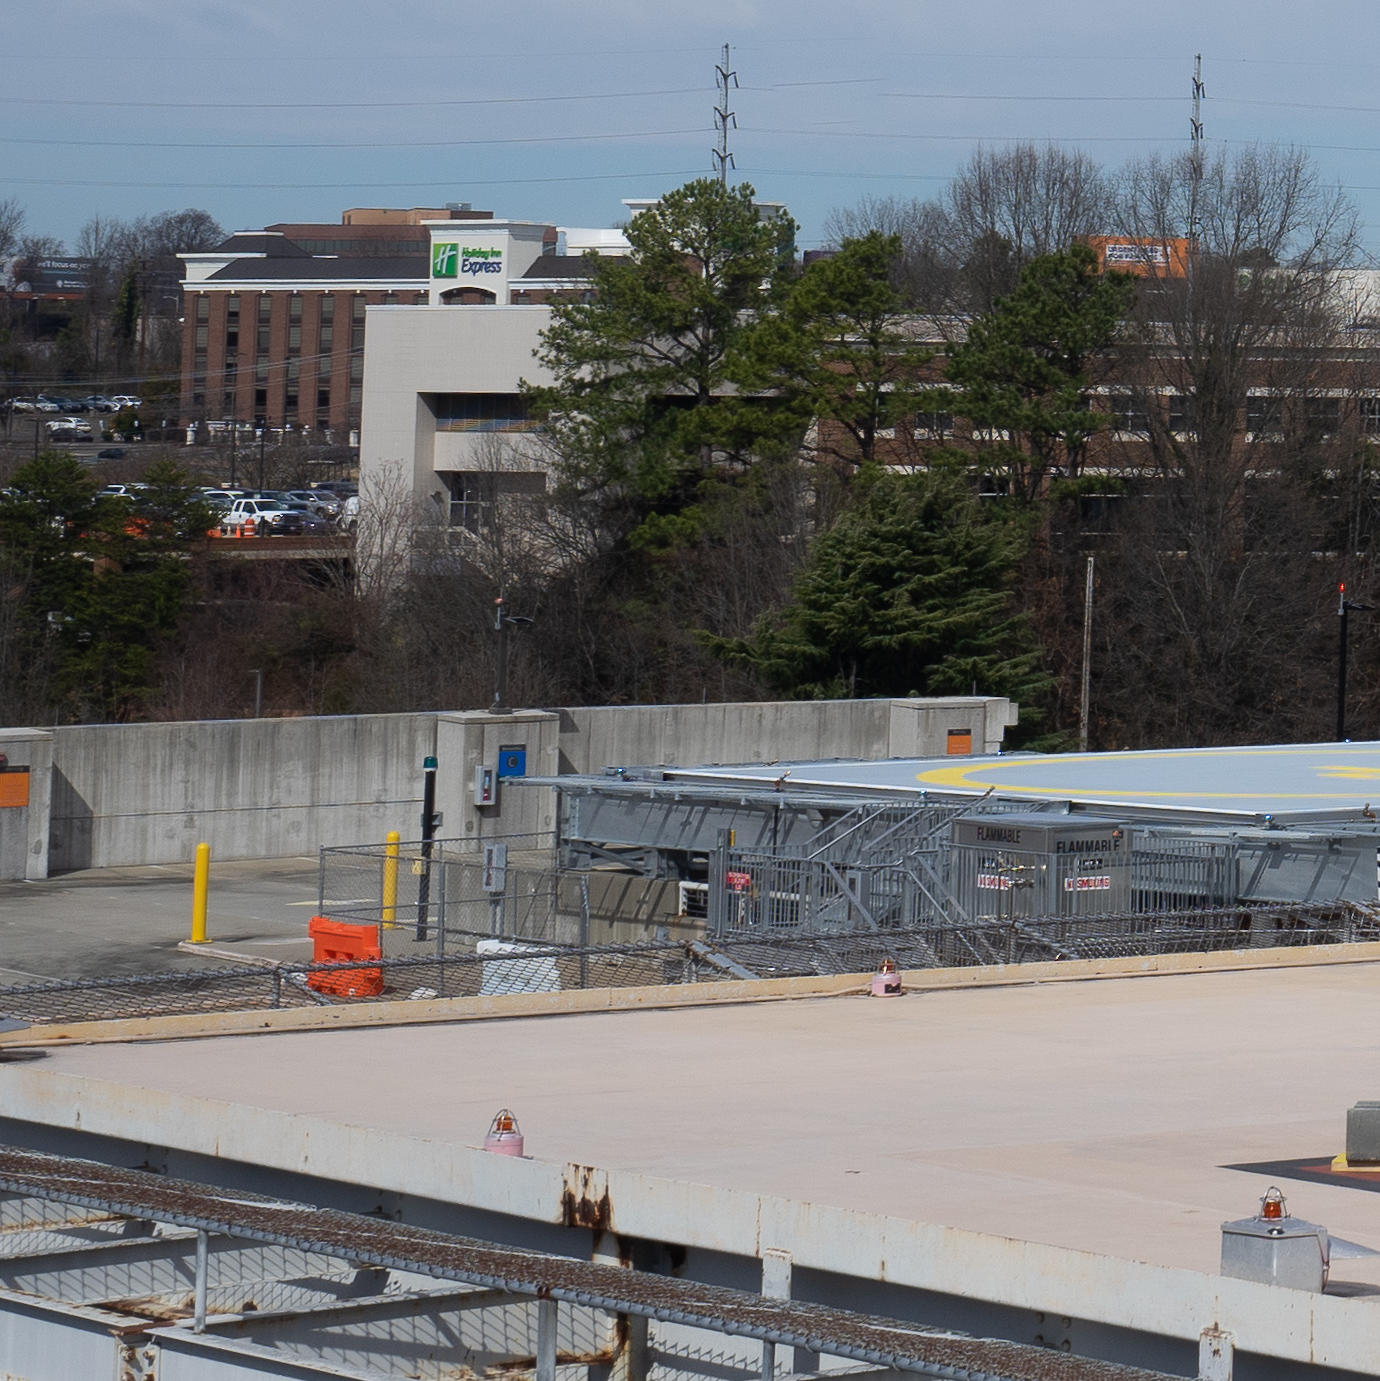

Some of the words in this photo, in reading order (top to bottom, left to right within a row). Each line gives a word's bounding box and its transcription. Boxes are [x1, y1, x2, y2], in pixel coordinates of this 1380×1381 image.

[462, 246, 489, 260] Holiday
[490, 246, 502, 258] Inn
[461, 258, 502, 277] Express
[976, 826, 1021, 844] FLAMMABLE
[1056, 839, 1121, 854] FLAMMABLE
